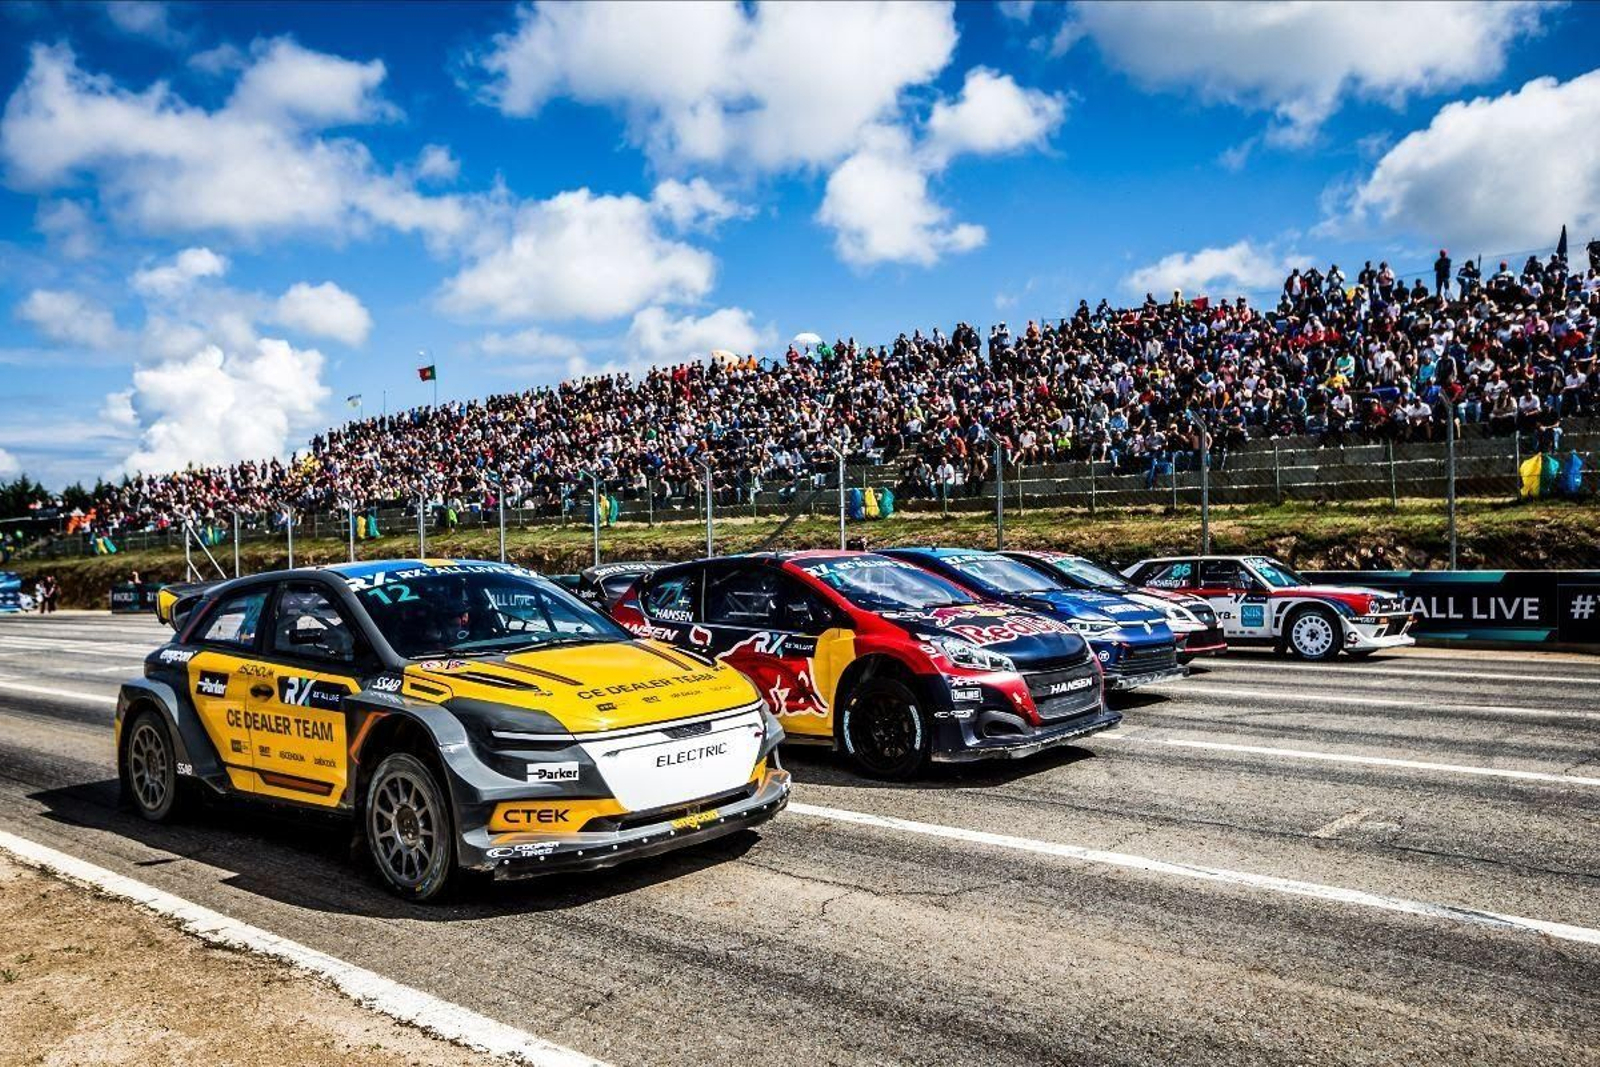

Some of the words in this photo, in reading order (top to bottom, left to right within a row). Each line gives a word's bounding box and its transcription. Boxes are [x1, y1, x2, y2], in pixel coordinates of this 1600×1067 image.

[368, 584, 419, 605] 12
[655, 609, 694, 623] HANSEN
[1409, 596, 1464, 619] ALL
[1472, 597, 1540, 620] LIVE
[623, 623, 679, 641] ANSEN
[754, 631, 789, 656] RX
[283, 677, 318, 707] RX
[372, 677, 401, 691] SSAB
[577, 688, 607, 699] CE
[605, 678, 673, 695] DEALER
[1050, 677, 1092, 694] HANSEN
[227, 708, 243, 728] CE
[244, 711, 293, 736] DEALER
[294, 718, 334, 742] TEAM
[656, 742, 726, 768] ELECTRIC
[176, 762, 193, 776] SSAB
[537, 768, 578, 780] Parker
[503, 809, 570, 823] CTEK
